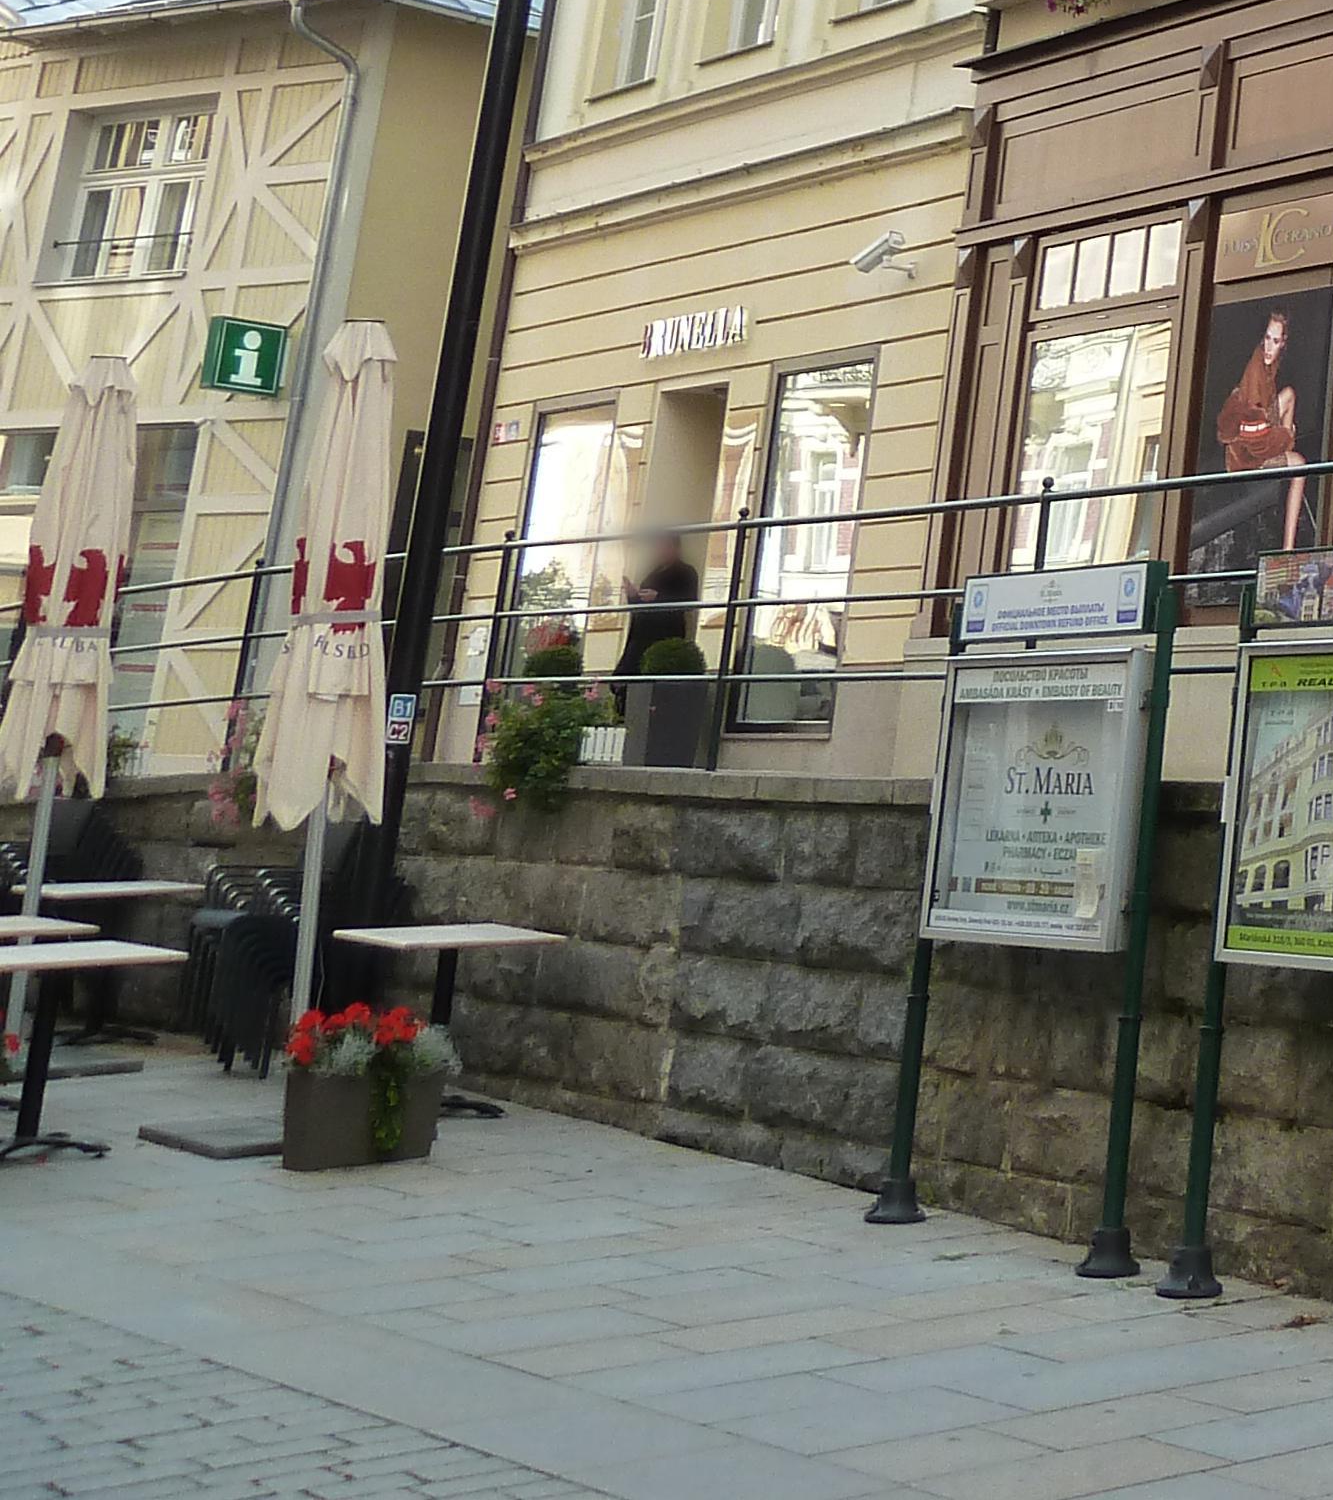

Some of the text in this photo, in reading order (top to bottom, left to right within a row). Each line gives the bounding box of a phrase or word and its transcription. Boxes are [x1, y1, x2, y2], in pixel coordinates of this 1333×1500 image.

[639, 304, 749, 360] BRUNELLA
[1041, 683, 1122, 697] EMBASSY OF BEAUTY
[393, 700, 412, 717] B1
[389, 724, 408, 740] C2
[1033, 767, 1094, 795] MARIA
